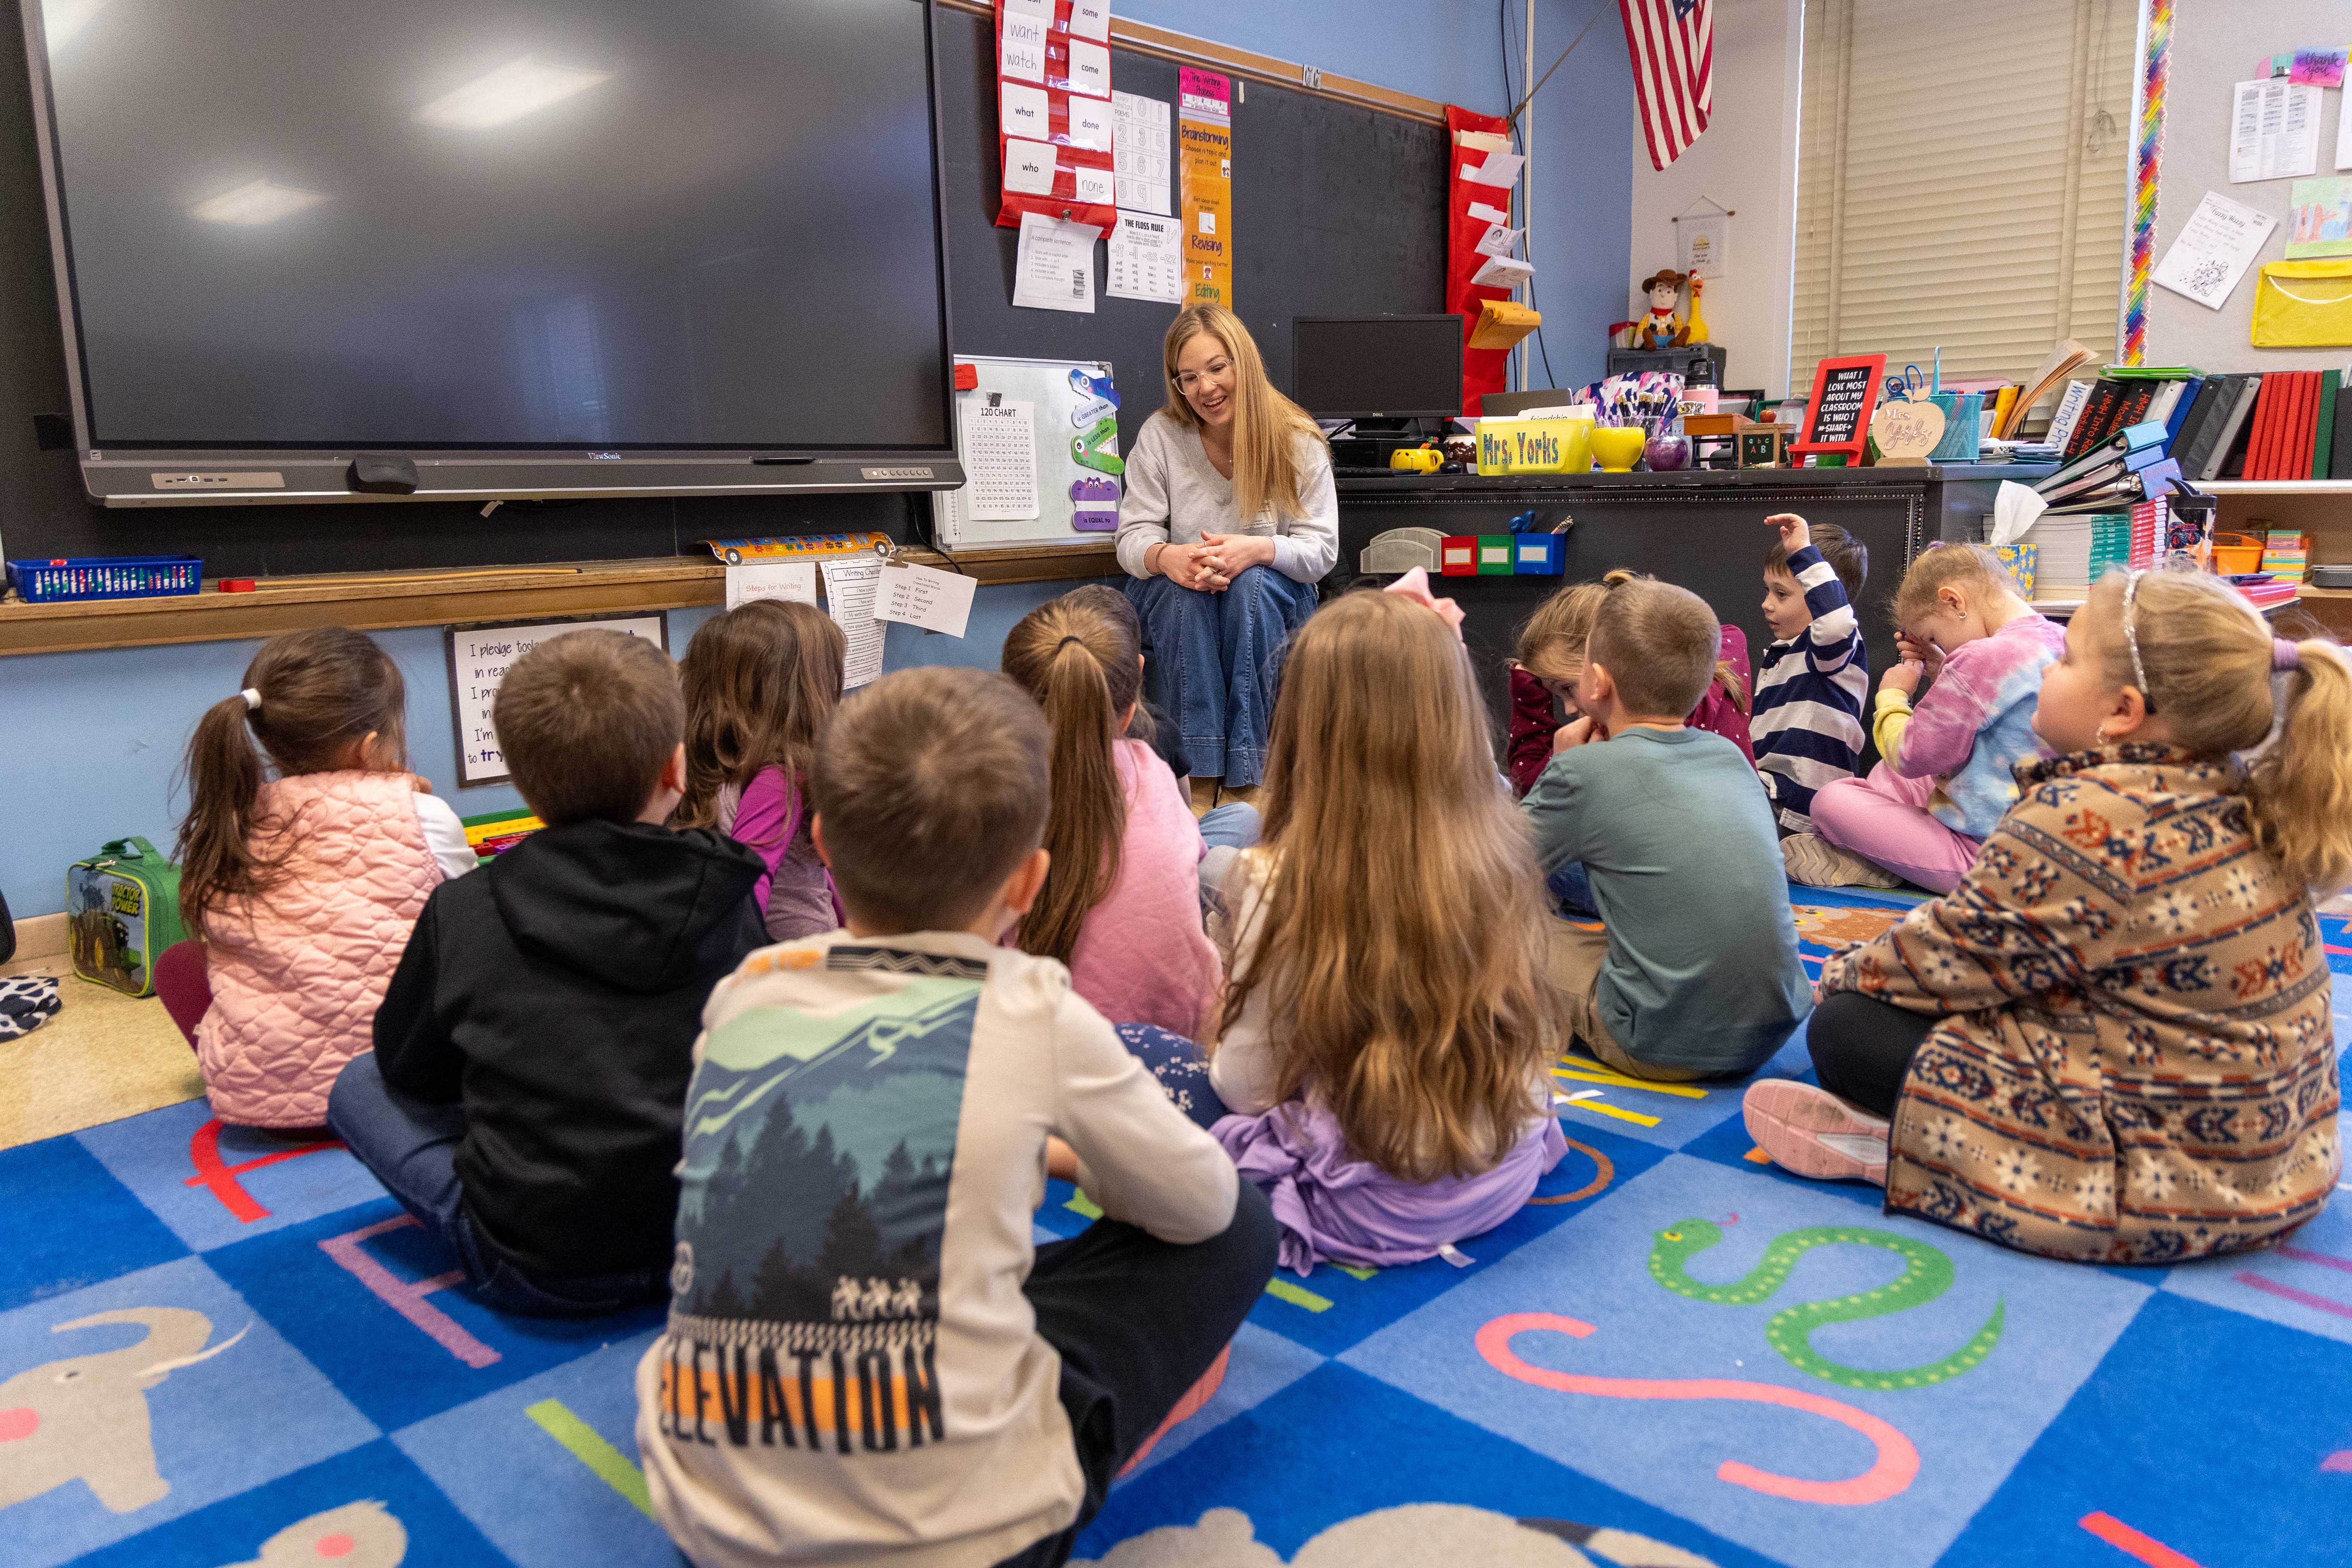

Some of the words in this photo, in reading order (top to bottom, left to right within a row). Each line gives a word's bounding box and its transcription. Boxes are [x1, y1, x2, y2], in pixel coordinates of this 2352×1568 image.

[1082, 8, 1098, 18] some
[1011, 24, 1039, 42] want
[1007, 50, 1037, 70] watch
[2299, 52, 2342, 67] thank
[1081, 64, 1099, 74] come
[2303, 65, 2331, 80] you
[1190, 71, 1200, 83] The
[1203, 74, 1221, 89] Writing
[1196, 85, 1215, 97] Process
[1015, 107, 1034, 118] what
[1115, 109, 1130, 118] POEMS
[1082, 119, 1099, 130] done
[1118, 124, 1127, 143] 2
[1138, 128, 1146, 146] 3
[1156, 132, 1165, 150] 4
[1182, 125, 1228, 150] Brainstorming
[1022, 162, 1039, 172] who
[1118, 151, 1127, 170] 5
[1137, 156, 1146, 174] 6
[1157, 159, 1165, 178] 7
[1082, 179, 1104, 194] none
[1118, 180, 1127, 199] 8
[1137, 184, 1147, 202] 9
[1125, 219, 1134, 228] THE
[1136, 220, 1149, 230] FLOSS
[1151, 223, 1164, 232] RULE
[1192, 234, 1222, 256] Revising
[1195, 282, 1220, 303] Editing
[1838, 371, 1858, 380] WHAT
[1859, 371, 1862, 379] I
[1828, 382, 1845, 391] LOVE
[1846, 381, 1867, 390] MOST
[1826, 392, 1850, 401] ABOUT
[1850, 392, 1863, 400] MY
[1821, 402, 1863, 412] CLASSROOM
[2054, 386, 2086, 426] Writing
[2098, 394, 2113, 415] HMH
[2135, 394, 2151, 415] HMH
[981, 408, 993, 416] 120
[994, 409, 1016, 417] CHART
[1081, 407, 1099, 420] GREATER
[1884, 409, 1911, 420] Mrs
[2107, 401, 2132, 436] Modules
[1825, 424, 1847, 432] SHARE
[2073, 403, 2095, 440] Modules
[2087, 416, 2104, 437] Into
[1091, 432, 1100, 442] LESS
[1100, 426, 1110, 435] than
[1820, 435, 1828, 443] IT
[1884, 418, 1932, 450] Yorks
[1483, 433, 1513, 466] Mrs.
[1516, 431, 1558, 464] Yorks
[843, 570, 864, 578] Writing
[779, 582, 801, 591] Writing
[914, 596, 933, 605] Second
[470, 644, 476, 657] I
[480, 642, 512, 658] pledge
[475, 668, 484, 679] in
[471, 687, 477, 699] I
[482, 708, 491, 719] in
[475, 727, 493, 741] I'm
[468, 753, 477, 764] to
[111, 897, 139, 914] POWER
